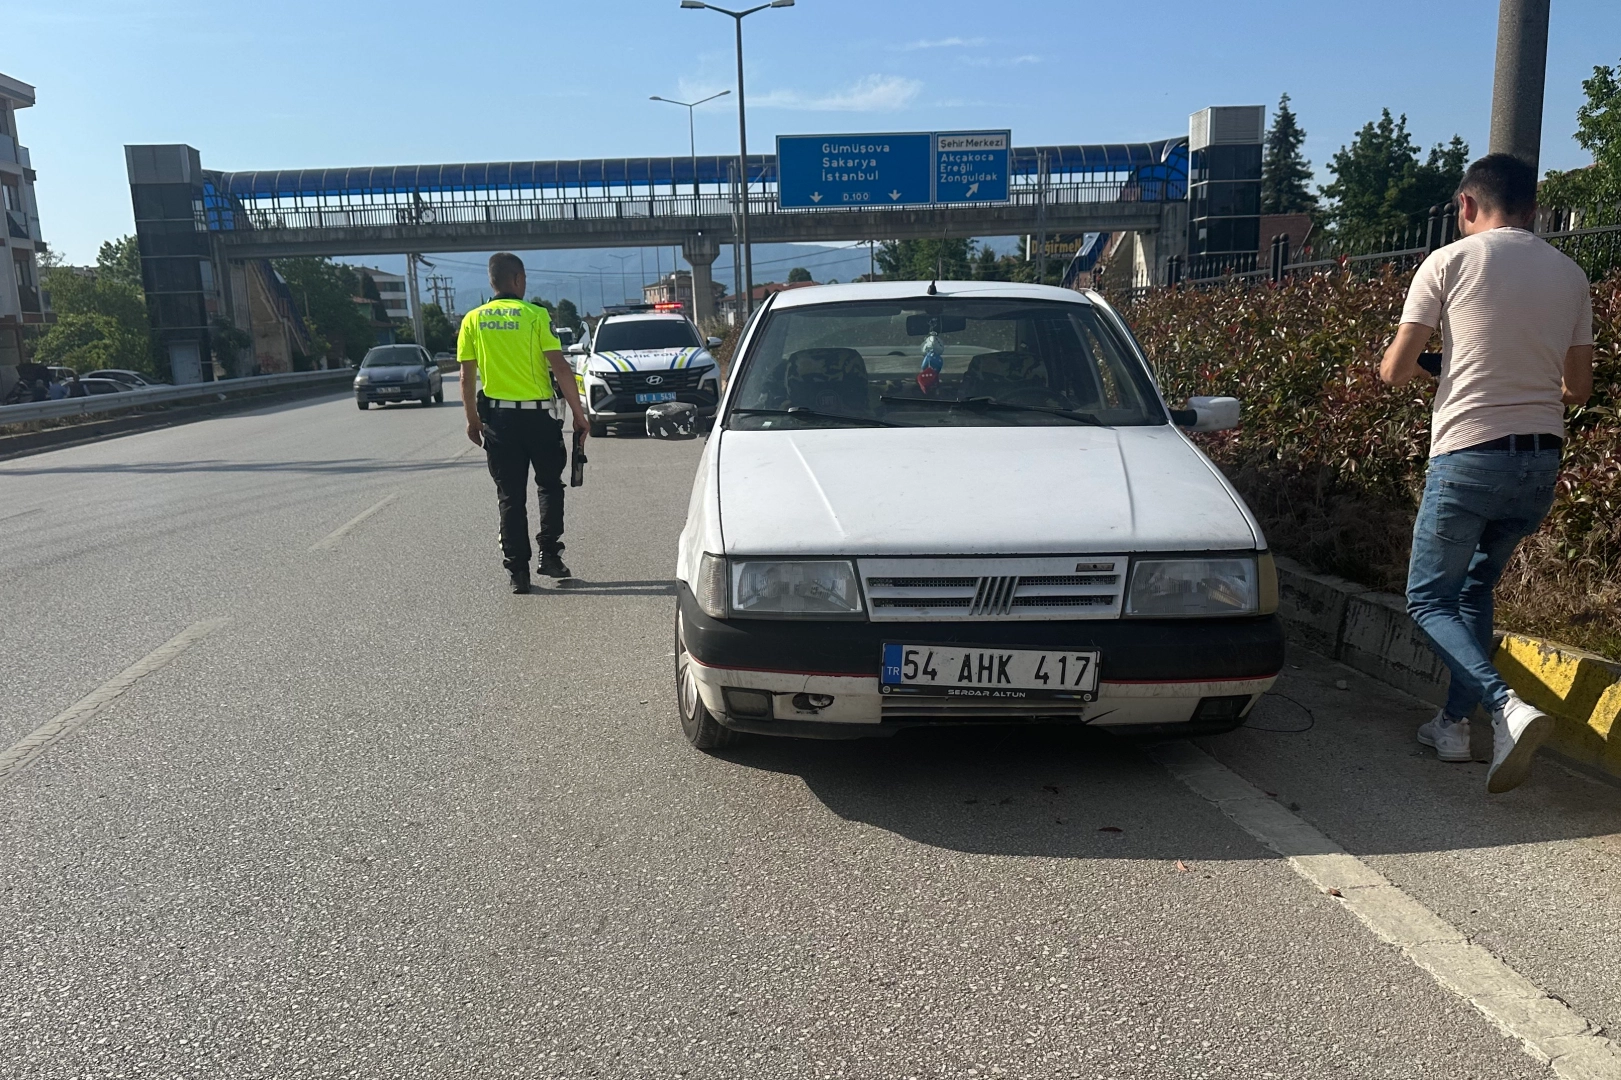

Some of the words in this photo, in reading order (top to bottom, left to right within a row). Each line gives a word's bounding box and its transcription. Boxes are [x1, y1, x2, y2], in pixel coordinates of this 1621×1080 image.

[940, 140, 964, 149] Şehir
[965, 138, 1003, 147] Merkezi
[822, 157, 877, 169] Sakarya
[940, 153, 994, 163] Akçakoca
[940, 163, 973, 174] Ereğli
[822, 169, 879, 181] İstanbul
[940, 172, 998, 184] Zonguldak
[843, 193, 869, 201] D.100
[887, 666, 900, 675] TR
[903, 650, 938, 681] 54
[957, 653, 1013, 684] AHK
[1034, 655, 1091, 686] 417
[947, 689, 990, 697] SERDAR
